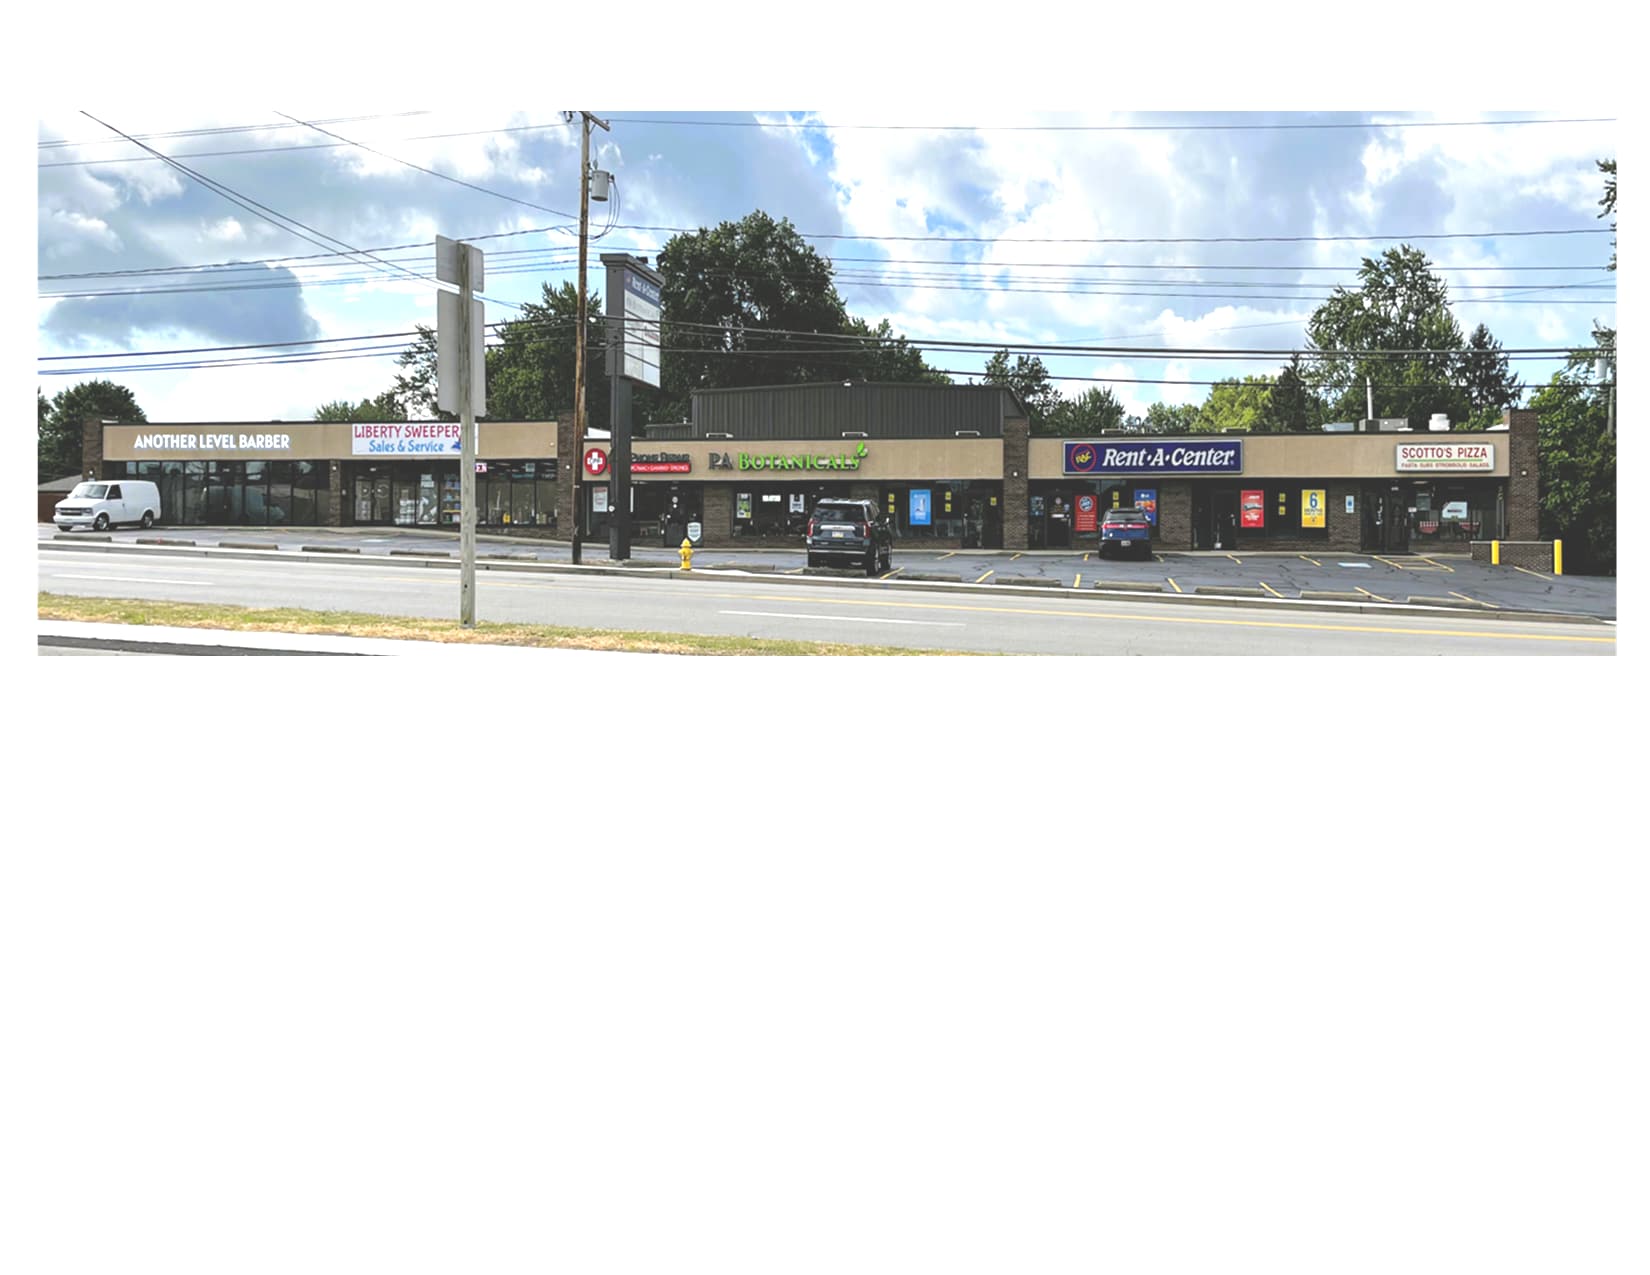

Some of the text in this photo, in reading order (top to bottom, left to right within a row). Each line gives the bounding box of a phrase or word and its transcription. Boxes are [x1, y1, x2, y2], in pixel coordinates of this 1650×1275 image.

[354, 425, 462, 438] LIBERTY SWEEPER
[134, 434, 290, 449] ANOTHER LEVEL BARBER
[369, 440, 444, 452] Sales & Service
[1402, 447, 1488, 459] SCOTTO'S PIZZA
[708, 452, 733, 470] PA
[738, 452, 860, 471] BOTANICALS
[1310, 492, 1318, 509] 6
